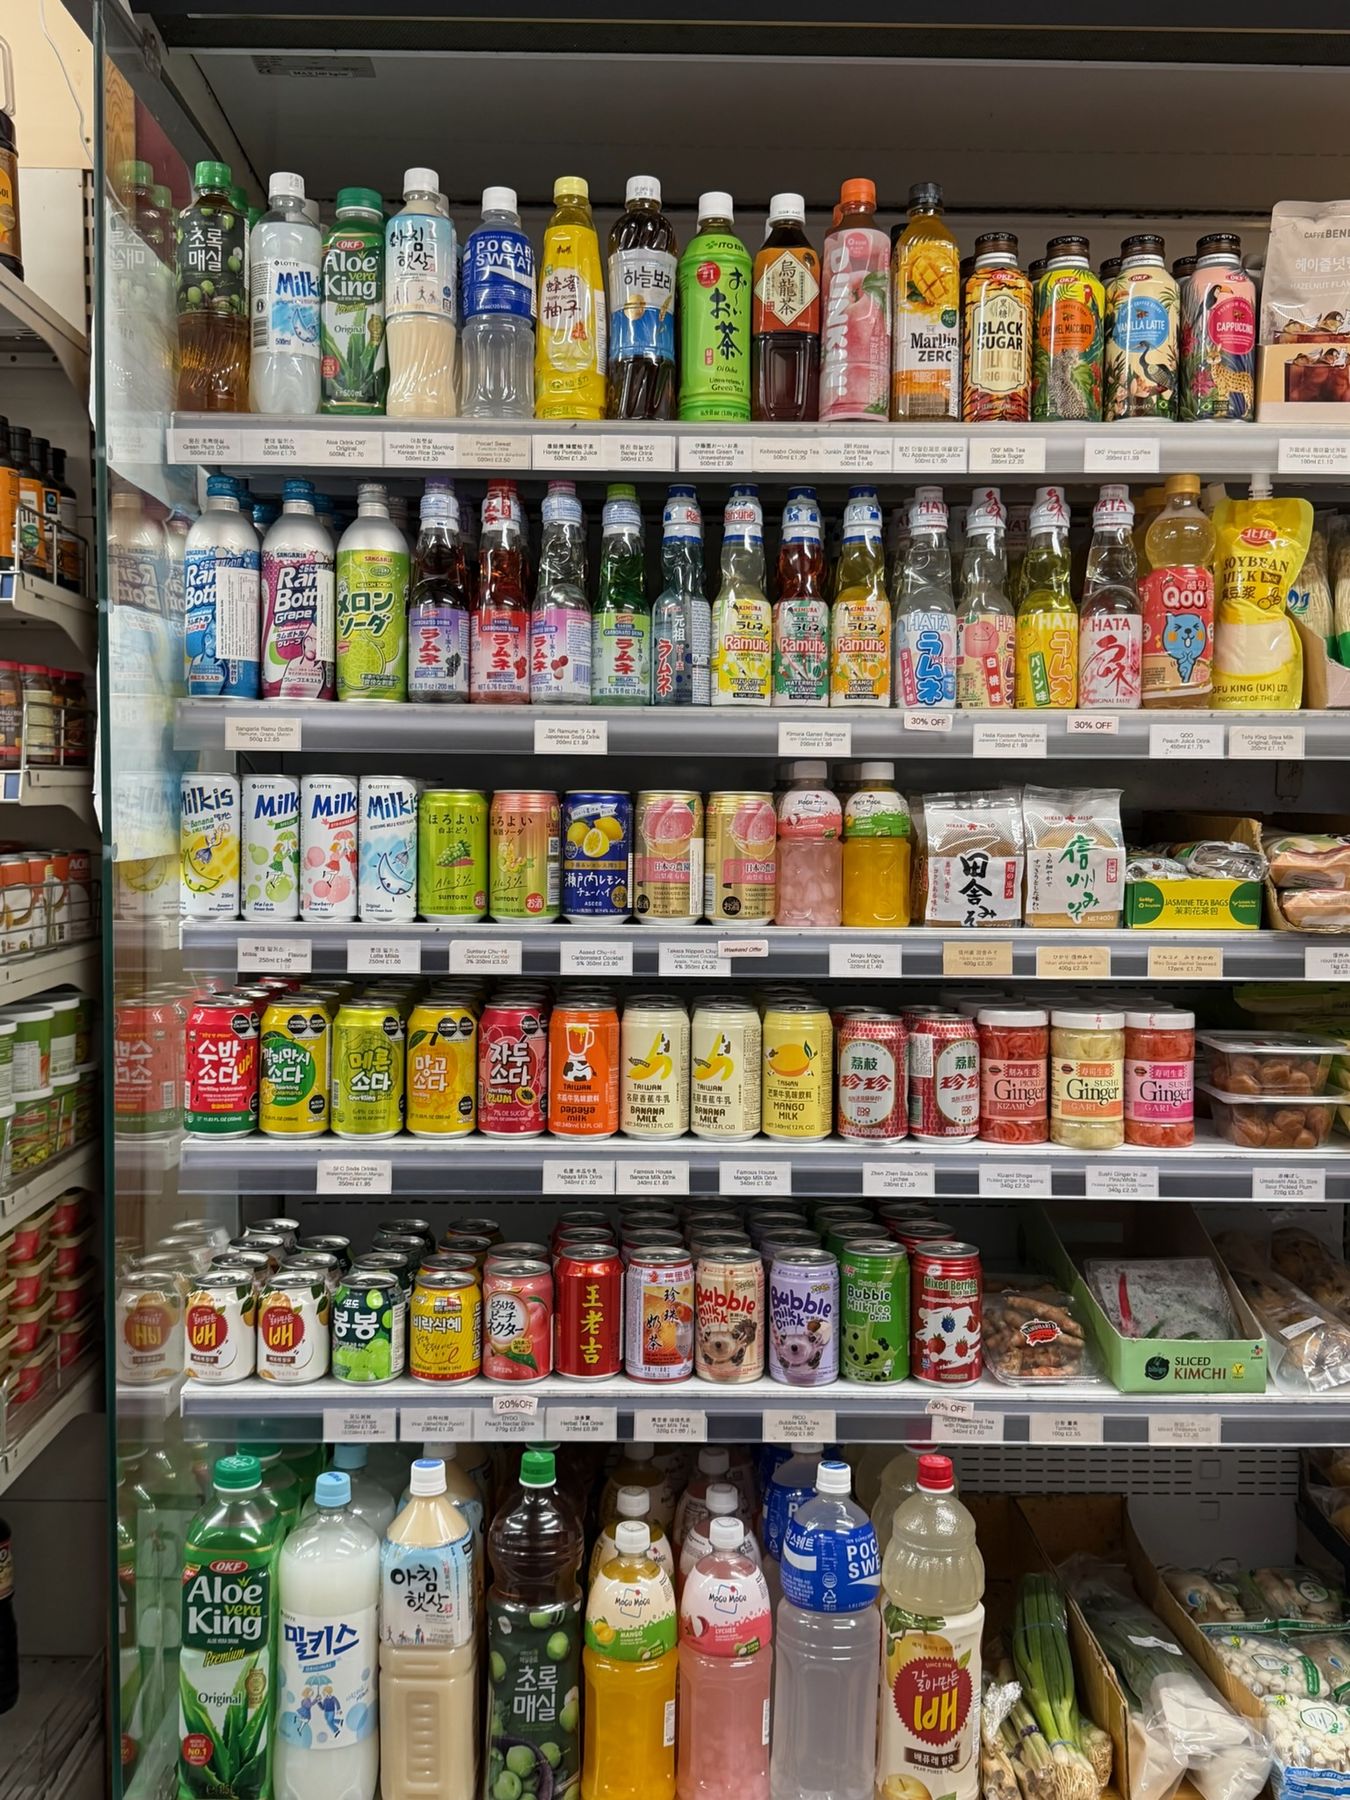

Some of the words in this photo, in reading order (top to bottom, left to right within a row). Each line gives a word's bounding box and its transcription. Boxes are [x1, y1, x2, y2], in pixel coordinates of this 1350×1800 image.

[189, 226, 223, 249] 초록
[340, 241, 360, 249] OKF
[390, 227, 424, 251] 아침
[718, 242, 734, 251] ITO
[188, 251, 222, 273] 매실
[323, 251, 377, 272] Aloe
[397, 252, 435, 271] 햇살
[476, 253, 532, 274] SWEAT
[276, 271, 321, 297] Milki
[349, 272, 377, 281] vera
[546, 274, 580, 294] 蜂蜜
[624, 268, 672, 292] 하늘보리
[324, 275, 377, 299] King
[778, 259, 797, 316] 烏龍茶
[543, 299, 581, 320] 柚子
[334, 325, 365, 335] Original
[710, 288, 741, 361] お茶
[978, 321, 1023, 336] BLACK
[1146, 320, 1165, 332] LATTE
[977, 336, 1023, 351] SUGAR
[711, 383, 731, 393] Green
[1224, 556, 1289, 572] SOYBEAN
[338, 592, 394, 613] メロン
[1163, 589, 1206, 609] Qoo
[275, 610, 312, 624] Grape
[339, 614, 391, 637] ソーダ
[907, 615, 951, 630] HATA
[1037, 616, 1076, 629] HATA
[1091, 618, 1131, 631] HATA
[673, 615, 685, 641] 元祖
[419, 628, 441, 665] ラムネ
[492, 634, 511, 671] ラムネ
[725, 637, 769, 652] Ramune
[782, 638, 826, 653] Ramune
[838, 638, 884, 653] Ramune
[533, 636, 547, 672] ラムネ
[614, 639, 635, 674] ラムネ
[657, 639, 673, 697] ラムネ
[916, 632, 943, 704] ラムネ
[1030, 654, 1049, 703] パイン味
[1229, 684, 1254, 693] KING
[1255, 683, 1275, 694] (UK)
[911, 717, 928, 726] 30%
[930, 718, 946, 726] OFF
[1074, 721, 1092, 730] 30%
[1094, 721, 1113, 730] OFF
[254, 792, 299, 820] Milk
[311, 792, 357, 820] Milk
[428, 813, 480, 826] ほろよい
[565, 871, 626, 889] 瀬戸内レモンの
[577, 888, 610, 898] チューハイ
[526, 898, 544, 909] お酒
[1165, 899, 1195, 907] JASMINE
[1196, 899, 1209, 907] TEA
[1211, 899, 1229, 907] BAGS
[1174, 907, 1218, 916] 茉莉花茶包
[198, 1040, 241, 1063] 수박
[348, 1048, 392, 1071] 메론
[489, 1043, 530, 1066] 자두
[415, 1055, 446, 1075] 망고
[850, 1056, 877, 1071] 荔枝
[198, 1065, 240, 1085] 소다
[267, 1065, 304, 1084] 소다
[351, 1072, 392, 1091] 소다
[414, 1074, 448, 1092] 소다
[489, 1066, 531, 1086] 소다
[488, 1092, 512, 1103] PLUM
[994, 1079, 1045, 1106] Ginger
[1065, 1079, 1118, 1106] Ginger
[1139, 1081, 1192, 1107] Ginger
[560, 1105, 595, 1116] papaya
[630, 1107, 665, 1115] BANANA
[773, 1102, 805, 1111] MANGO
[997, 1103, 1025, 1111] KIZAMI
[1070, 1103, 1096, 1111] GARI
[1144, 1103, 1170, 1111] GARI
[566, 1114, 587, 1122] milk
[636, 1114, 658, 1122] MILK
[778, 1112, 798, 1121] MILK
[847, 1286, 891, 1302] Bubble
[924, 1278, 949, 1292] Mixed
[950, 1278, 977, 1294] Berries
[491, 1300, 515, 1310] とろける
[696, 1283, 756, 1314] Bubble
[770, 1285, 832, 1316] Bubble
[334, 1310, 379, 1340] 봉봉
[413, 1316, 462, 1334] 비락식혜
[490, 1312, 516, 1321] ピーチ
[580, 1285, 604, 1364] 王老吉
[700, 1311, 728, 1327] Drink
[488, 1321, 524, 1337] ネクター
[1175, 1357, 1211, 1367] SLICED
[1174, 1367, 1226, 1380] KIMCHI
[931, 1402, 948, 1411] 30%
[950, 1404, 967, 1413] OFF
[215, 1562, 242, 1572] OKF
[391, 1565, 437, 1591] 아침
[188, 1576, 264, 1604] Aloe
[225, 1604, 261, 1617] vera
[404, 1593, 449, 1613] 햇살
[189, 1613, 263, 1640] King
[620, 1630, 643, 1638] MANGO
[715, 1627, 737, 1635] LYCHEE
[285, 1624, 359, 1662] 밀키스
[203, 1648, 245, 1667] Premium
[515, 1665, 558, 1693] 초록
[912, 1670, 960, 1693] 갈아만든
[198, 1693, 242, 1706] Original
[513, 1695, 555, 1723] 매실
[188, 1747, 207, 1756] NO.1
